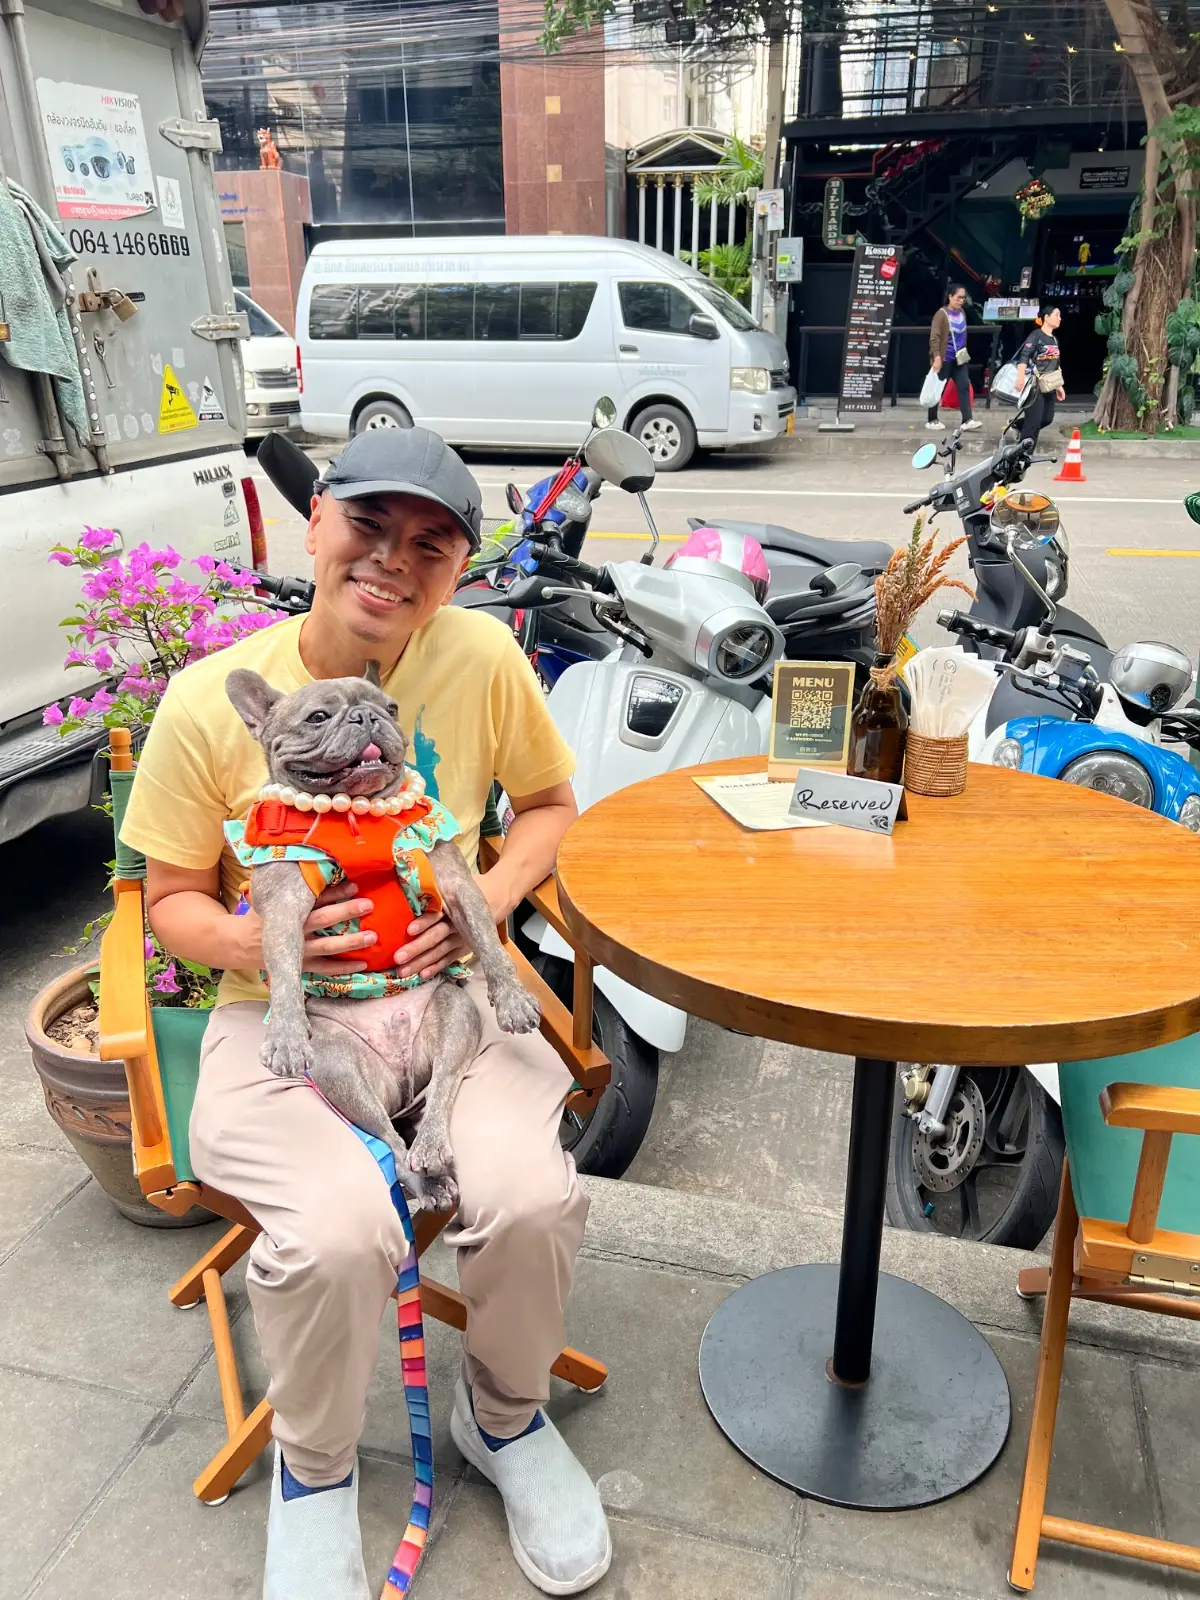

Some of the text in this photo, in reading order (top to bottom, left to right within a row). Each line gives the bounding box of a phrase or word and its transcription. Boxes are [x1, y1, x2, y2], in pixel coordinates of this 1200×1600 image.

[101, 95, 137, 109] HIKVISION
[827, 180, 840, 246] BILLIARDS
[69, 229, 191, 257] 064 146 6669
[193, 464, 233, 486] HILUX
[792, 676, 834, 688] MENU
[797, 788, 894, 810] Reserved
